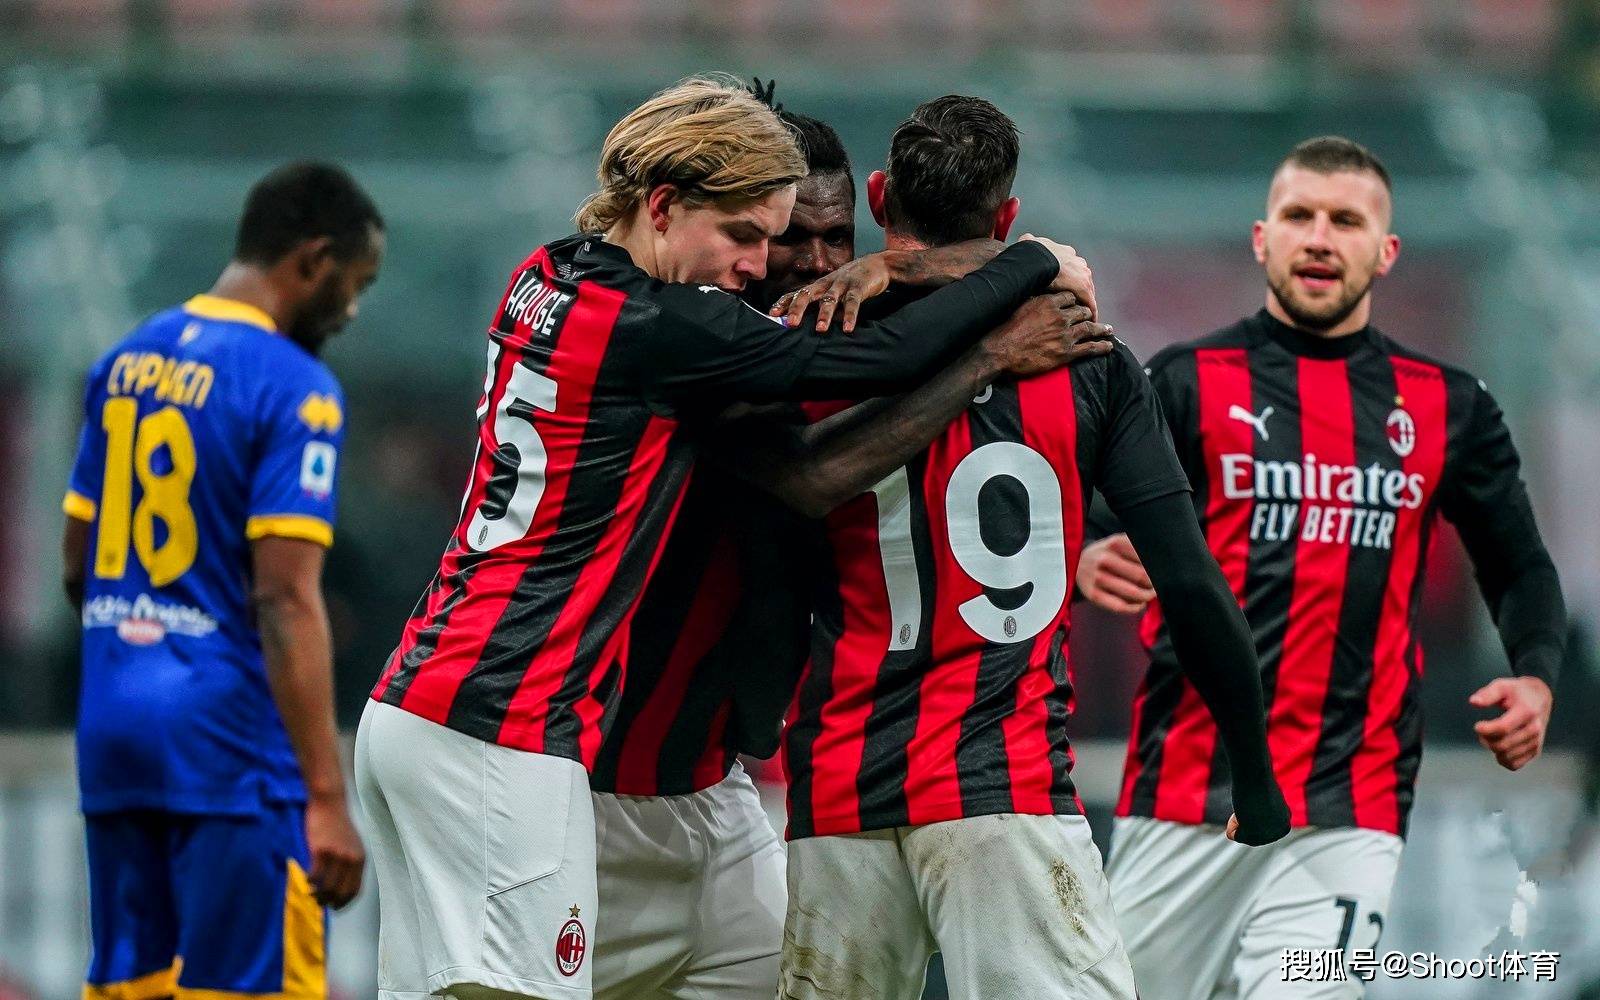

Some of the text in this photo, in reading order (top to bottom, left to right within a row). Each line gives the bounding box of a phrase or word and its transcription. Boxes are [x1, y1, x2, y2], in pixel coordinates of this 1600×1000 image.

[505, 270, 570, 336] HAUGE
[94, 396, 198, 588] 18
[1220, 453, 1425, 510] Emirates
[872, 441, 1067, 651] 19
[1250, 502, 1396, 550] FLY BETTER
